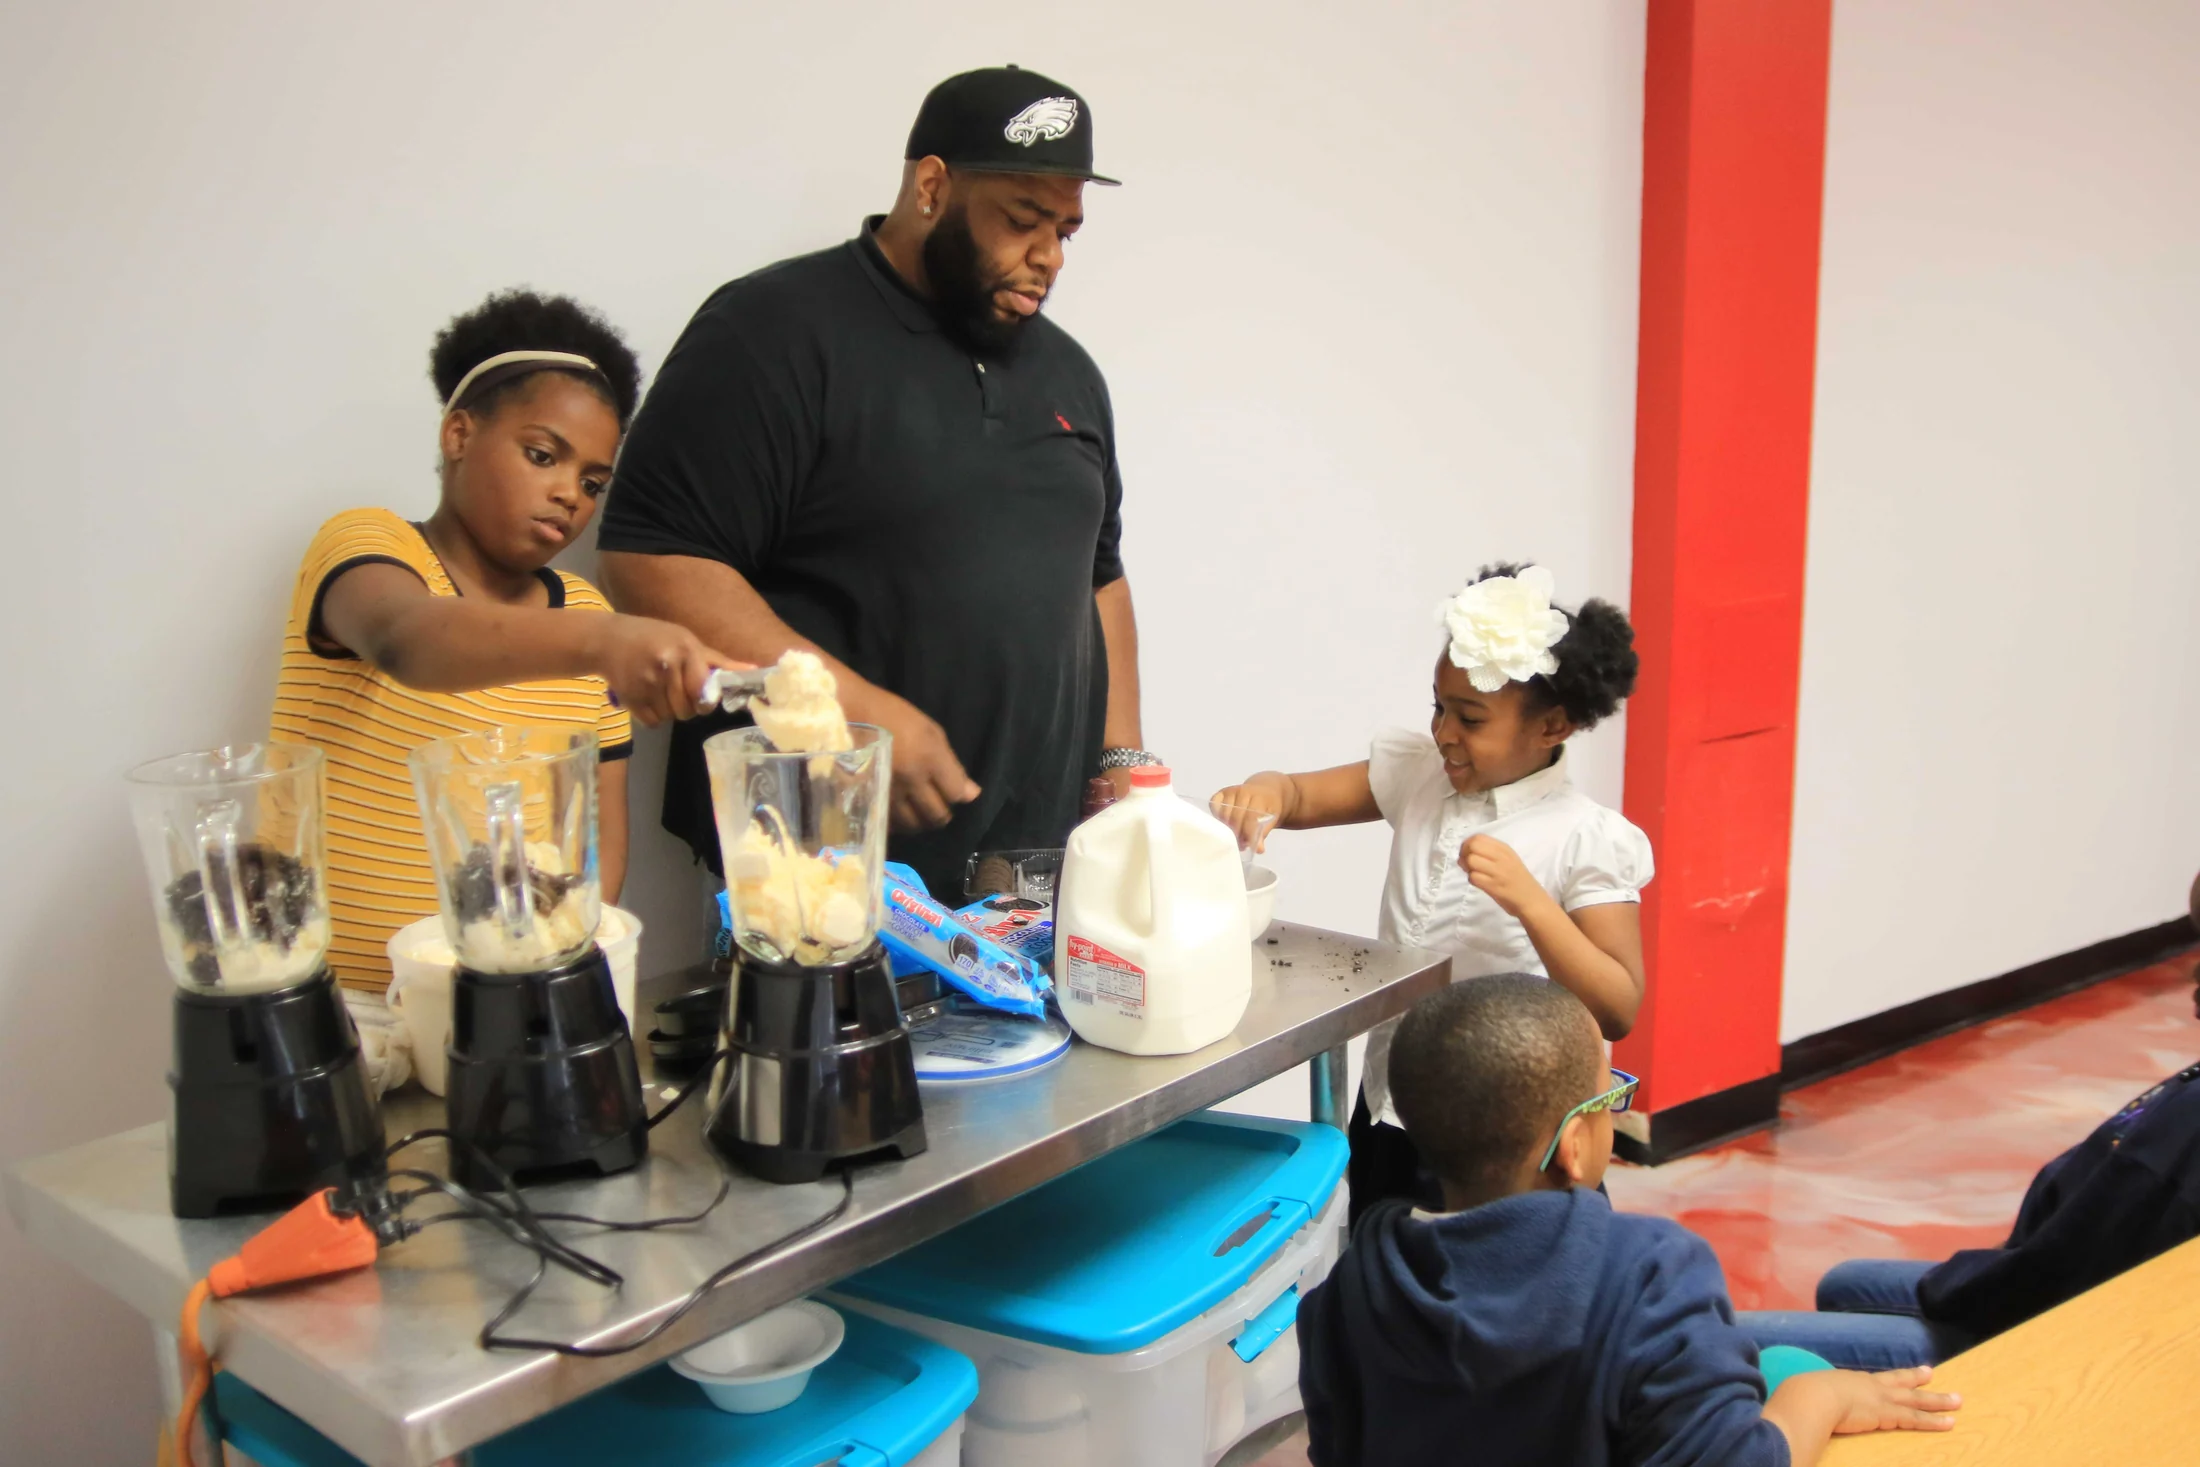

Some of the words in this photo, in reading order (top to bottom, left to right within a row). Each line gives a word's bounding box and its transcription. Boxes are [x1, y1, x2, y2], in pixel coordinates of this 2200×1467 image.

[891, 890, 943, 927] Original
[894, 908, 927, 931] CHOCOLATE
[958, 955, 972, 968] 170
